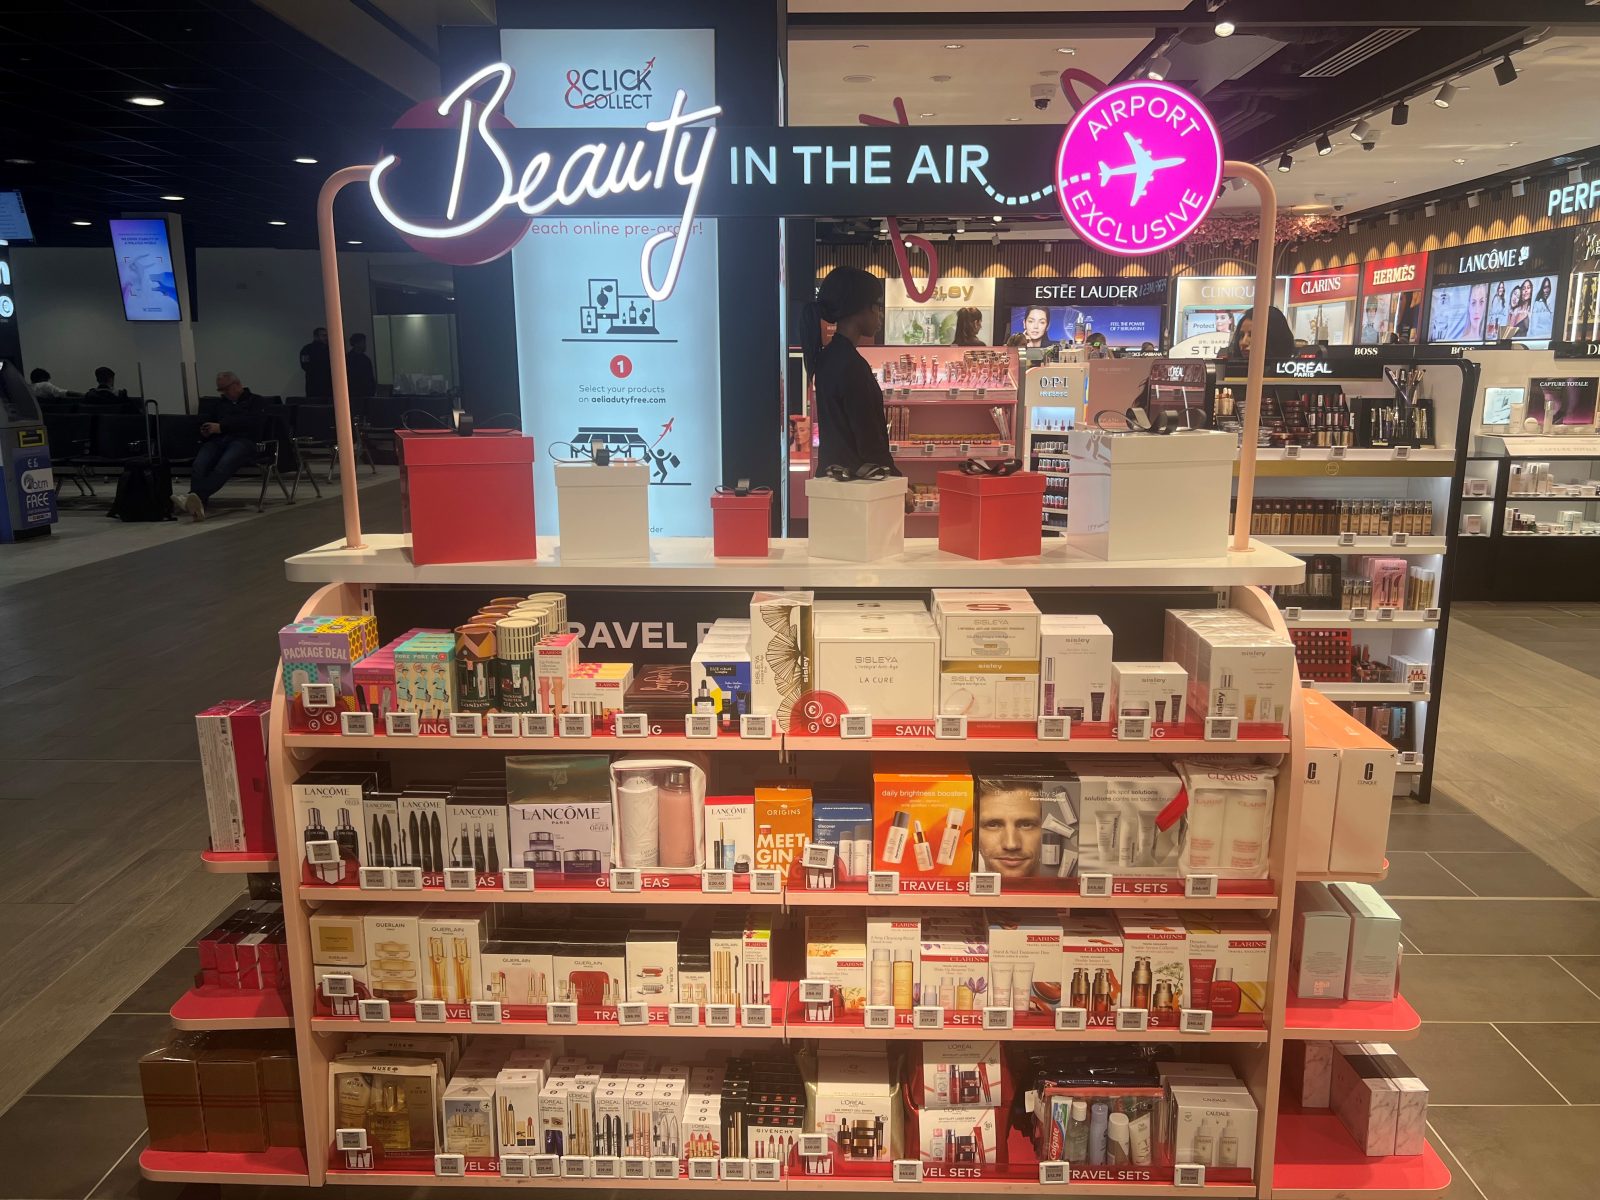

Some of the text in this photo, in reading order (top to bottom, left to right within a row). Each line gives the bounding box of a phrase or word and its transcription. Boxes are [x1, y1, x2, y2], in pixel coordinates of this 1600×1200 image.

[582, 69, 652, 91] CLICK
[583, 94, 652, 109] COLLECT
[1087, 95, 1201, 142] AIRPORT
[369, 62, 990, 301] Beauty IN THE AIR
[1071, 187, 1203, 244] EXCLUSIVE
[531, 221, 619, 235] each online
[1458, 248, 1517, 274] LANCÔME
[1301, 276, 1341, 295] CLARINS
[1080, 285, 1138, 299] LAUDER
[1201, 286, 1255, 298] CLINIQU
[1354, 347, 1378, 355] BOSS
[616, 360, 625, 373] 1
[579, 384, 665, 395] Select your products
[566, 621, 688, 649] RAVEL
[1065, 637, 1090, 645] sisley
[283, 646, 347, 660] PACKAGE DEAL
[1216, 692, 1225, 717] isley
[417, 722, 447, 734] VING
[895, 725, 935, 736] SAVIN
[1207, 772, 1258, 782] CLARINS
[304, 786, 350, 796] LANCÔME
[881, 790, 898, 798] daily
[899, 789, 936, 798] brightness
[401, 800, 441, 809] LANCÔME
[711, 805, 748, 815] LANCÔME
[453, 807, 499, 817] LANCÔME
[521, 805, 601, 821] LANCÔME
[766, 808, 801, 816] ORIGINS
[756, 832, 805, 849] MEET
[756, 849, 793, 864] GIN
[422, 876, 444, 886] GIF
[596, 878, 609, 888] GI
[901, 881, 970, 891] TRAVEL SE
[1134, 883, 1168, 893] SETS
[594, 1011, 617, 1020] TRA
[953, 1014, 983, 1024] SETS
[1049, 1127, 1060, 1161] Colgate
[922, 1167, 946, 1177] VEL
[949, 1168, 981, 1178] SETS
[1069, 1170, 1150, 1180] TRAVEL SETS
